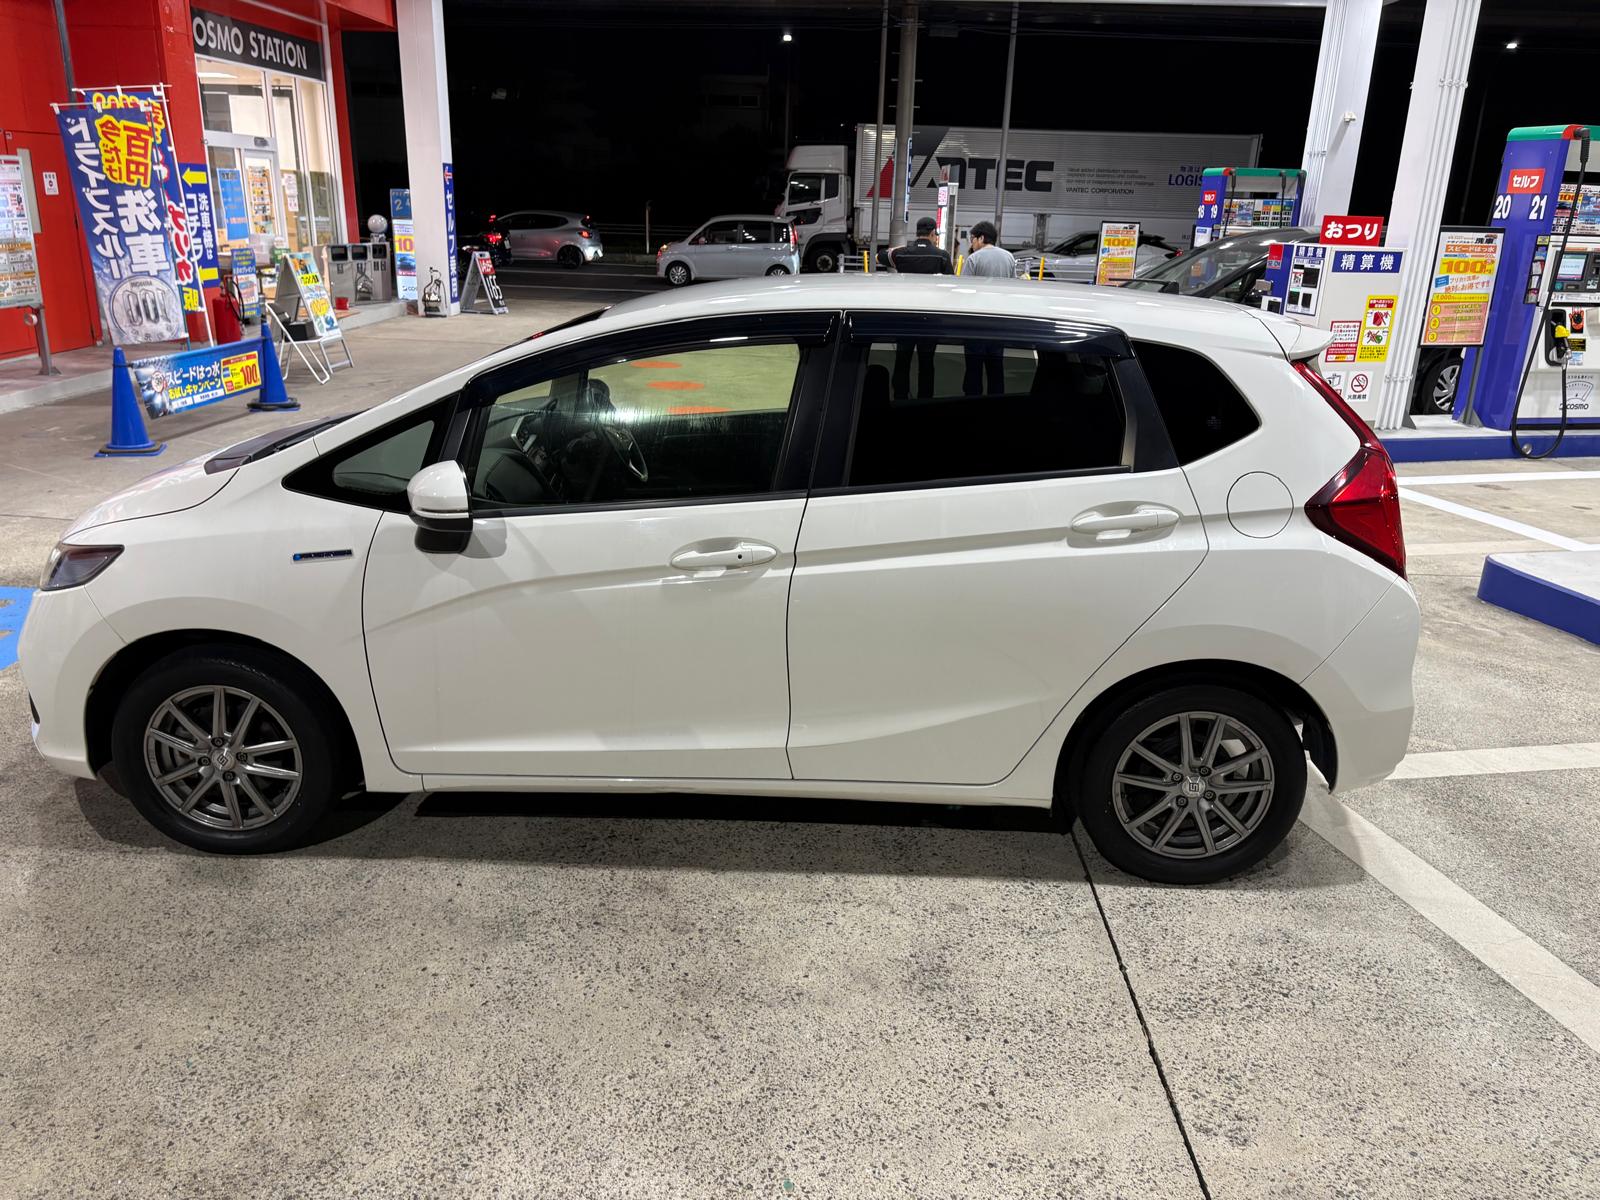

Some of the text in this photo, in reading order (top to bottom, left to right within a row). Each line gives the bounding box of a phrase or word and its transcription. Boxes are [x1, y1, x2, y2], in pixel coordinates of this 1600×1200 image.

[192, 16, 308, 70] OSMO STATION
[1512, 174, 1540, 188] セルフ
[1210, 204, 1218, 219] 19
[1493, 195, 1548, 220] 20 21
[1324, 221, 1378, 240] おつり
[1340, 253, 1394, 271] 精算機
[167, 361, 221, 387] スピードはっ水
[240, 363, 259, 386] 100
[168, 378, 221, 400] お試しキャンペーン
